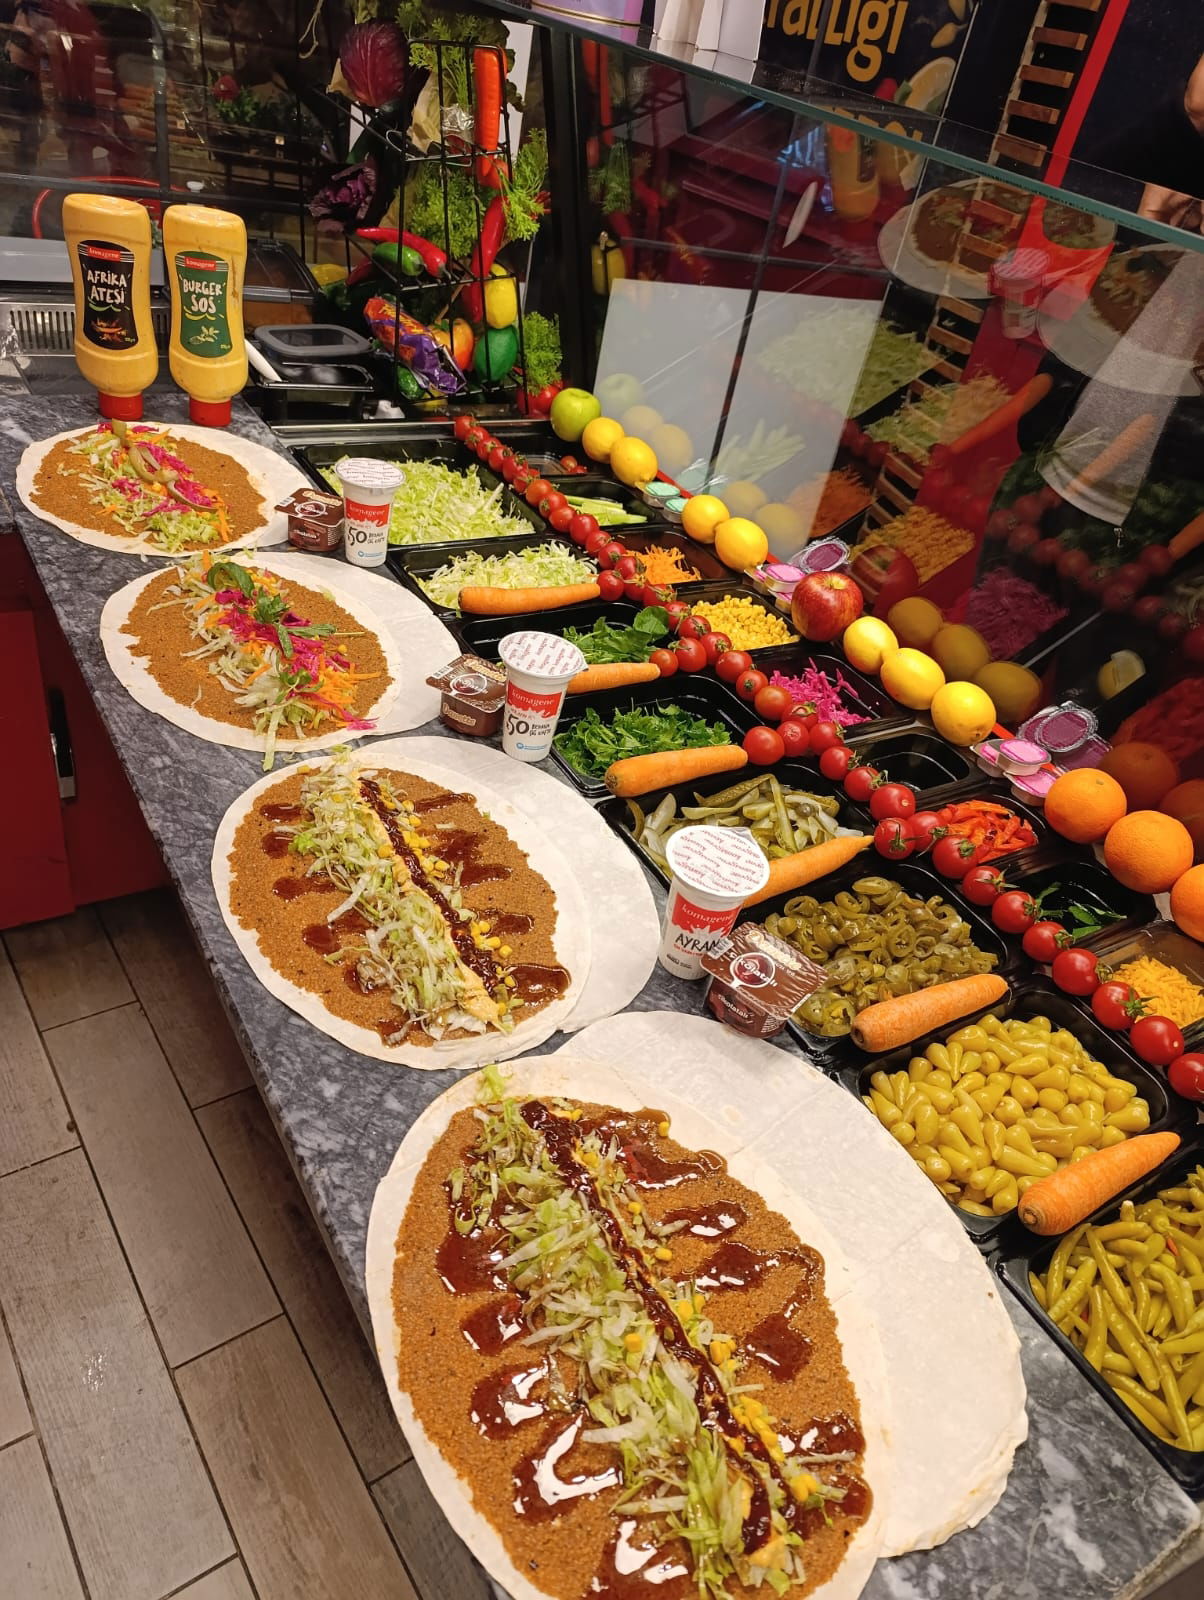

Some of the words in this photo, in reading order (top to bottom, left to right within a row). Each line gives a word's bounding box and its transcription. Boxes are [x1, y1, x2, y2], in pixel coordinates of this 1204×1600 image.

[87, 269, 127, 287] AFRİKA
[183, 278, 222, 296] BURGER
[191, 294, 217, 313] SOS
[348, 526, 367, 546] 50
[508, 713, 530, 735] 50
[675, 933, 720, 952] AYRAN
